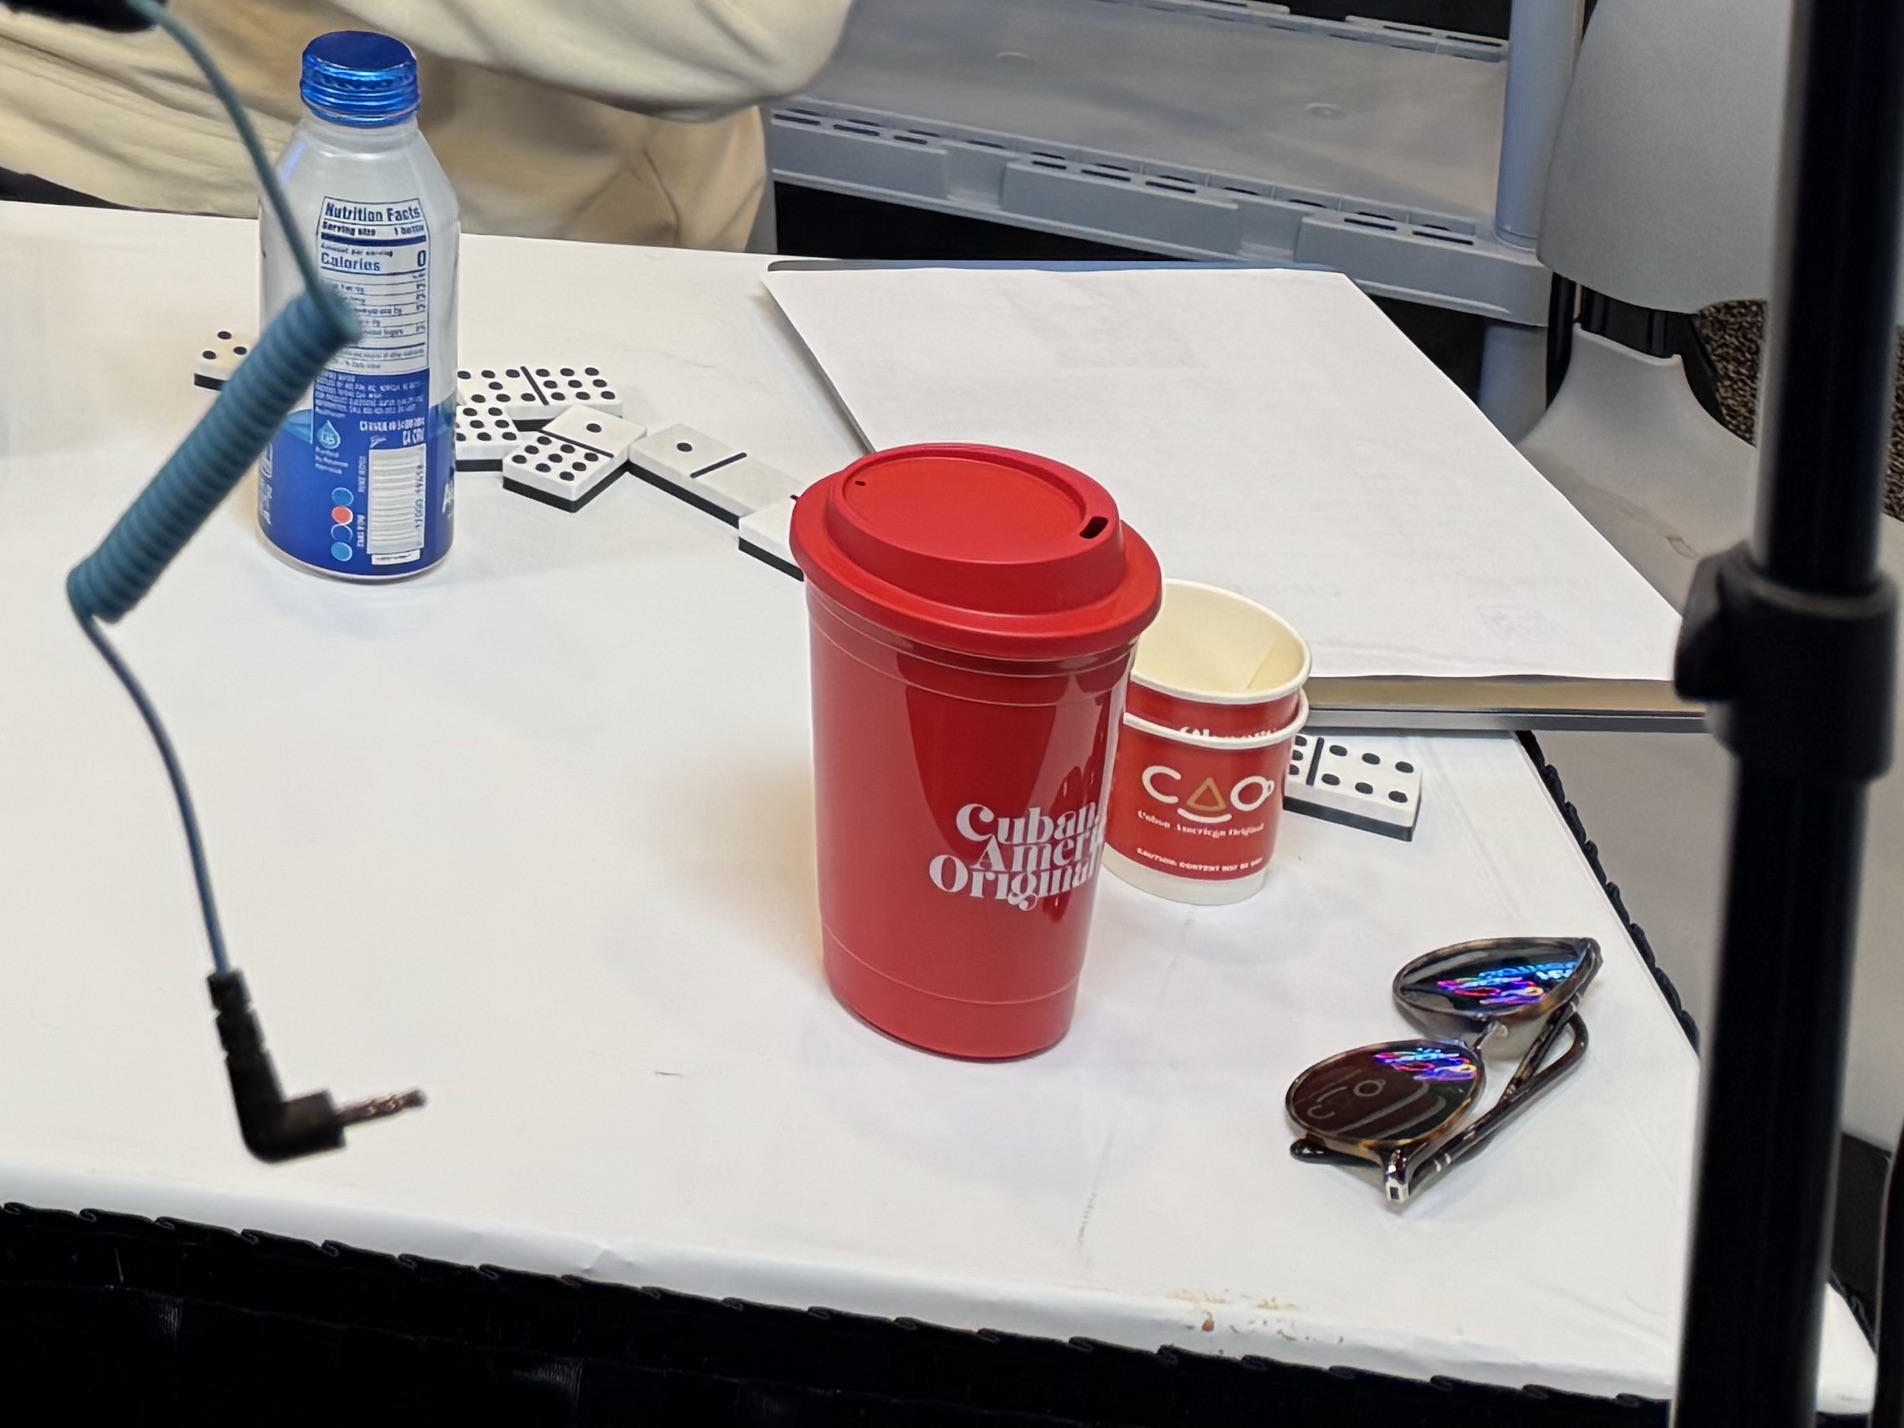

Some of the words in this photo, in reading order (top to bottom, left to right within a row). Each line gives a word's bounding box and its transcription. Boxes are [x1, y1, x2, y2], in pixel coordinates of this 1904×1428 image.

[325, 202, 383, 223] Nutrition
[386, 206, 421, 222] Facts
[321, 252, 381, 272] Calories
[417, 250, 427, 267] 0
